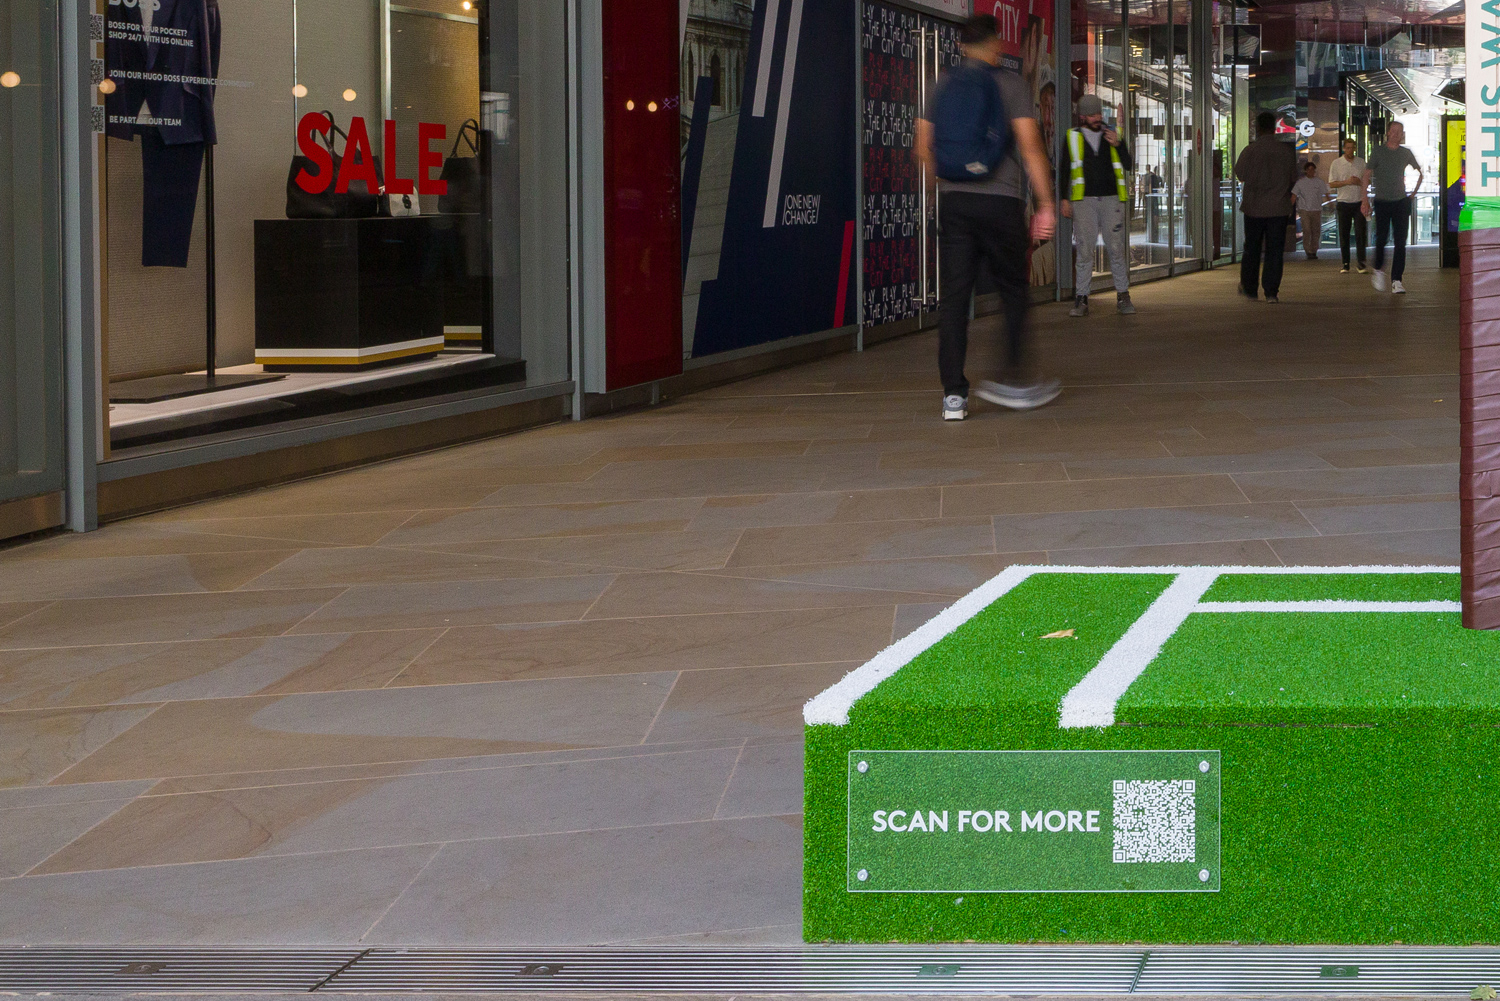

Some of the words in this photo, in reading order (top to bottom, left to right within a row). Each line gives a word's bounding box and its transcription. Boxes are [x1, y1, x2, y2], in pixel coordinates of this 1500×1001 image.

[108, 20, 126, 30] BOSS
[126, 23, 140, 31] FOR
[141, 24, 159, 34] YOUR
[160, 27, 188, 37] POCKET?
[992, 0, 1020, 44] CITY
[108, 31, 127, 40] SHOP
[128, 33, 142, 42] 24/7
[143, 34, 160, 44] WITH
[160, 37, 169, 45] US
[170, 38, 194, 47] ONLINE
[109, 69, 126, 78] JOIN
[126, 71, 142, 79] OUR
[142, 72, 163, 81] HUGO
[163, 74, 181, 83] BOSS
[181, 75, 218, 85] EXPERIENCE
[109, 115, 119, 123] BE
[119, 116, 137, 124] PART
[148, 117, 163, 125] OUR
[163, 118, 182, 126] TEAM
[1300, 120, 1315, 137] G
[295, 111, 448, 196] SALE
[872, 810, 948, 833] SCAN
[958, 810, 1013, 832] FOR
[1021, 810, 1100, 832] MORE
